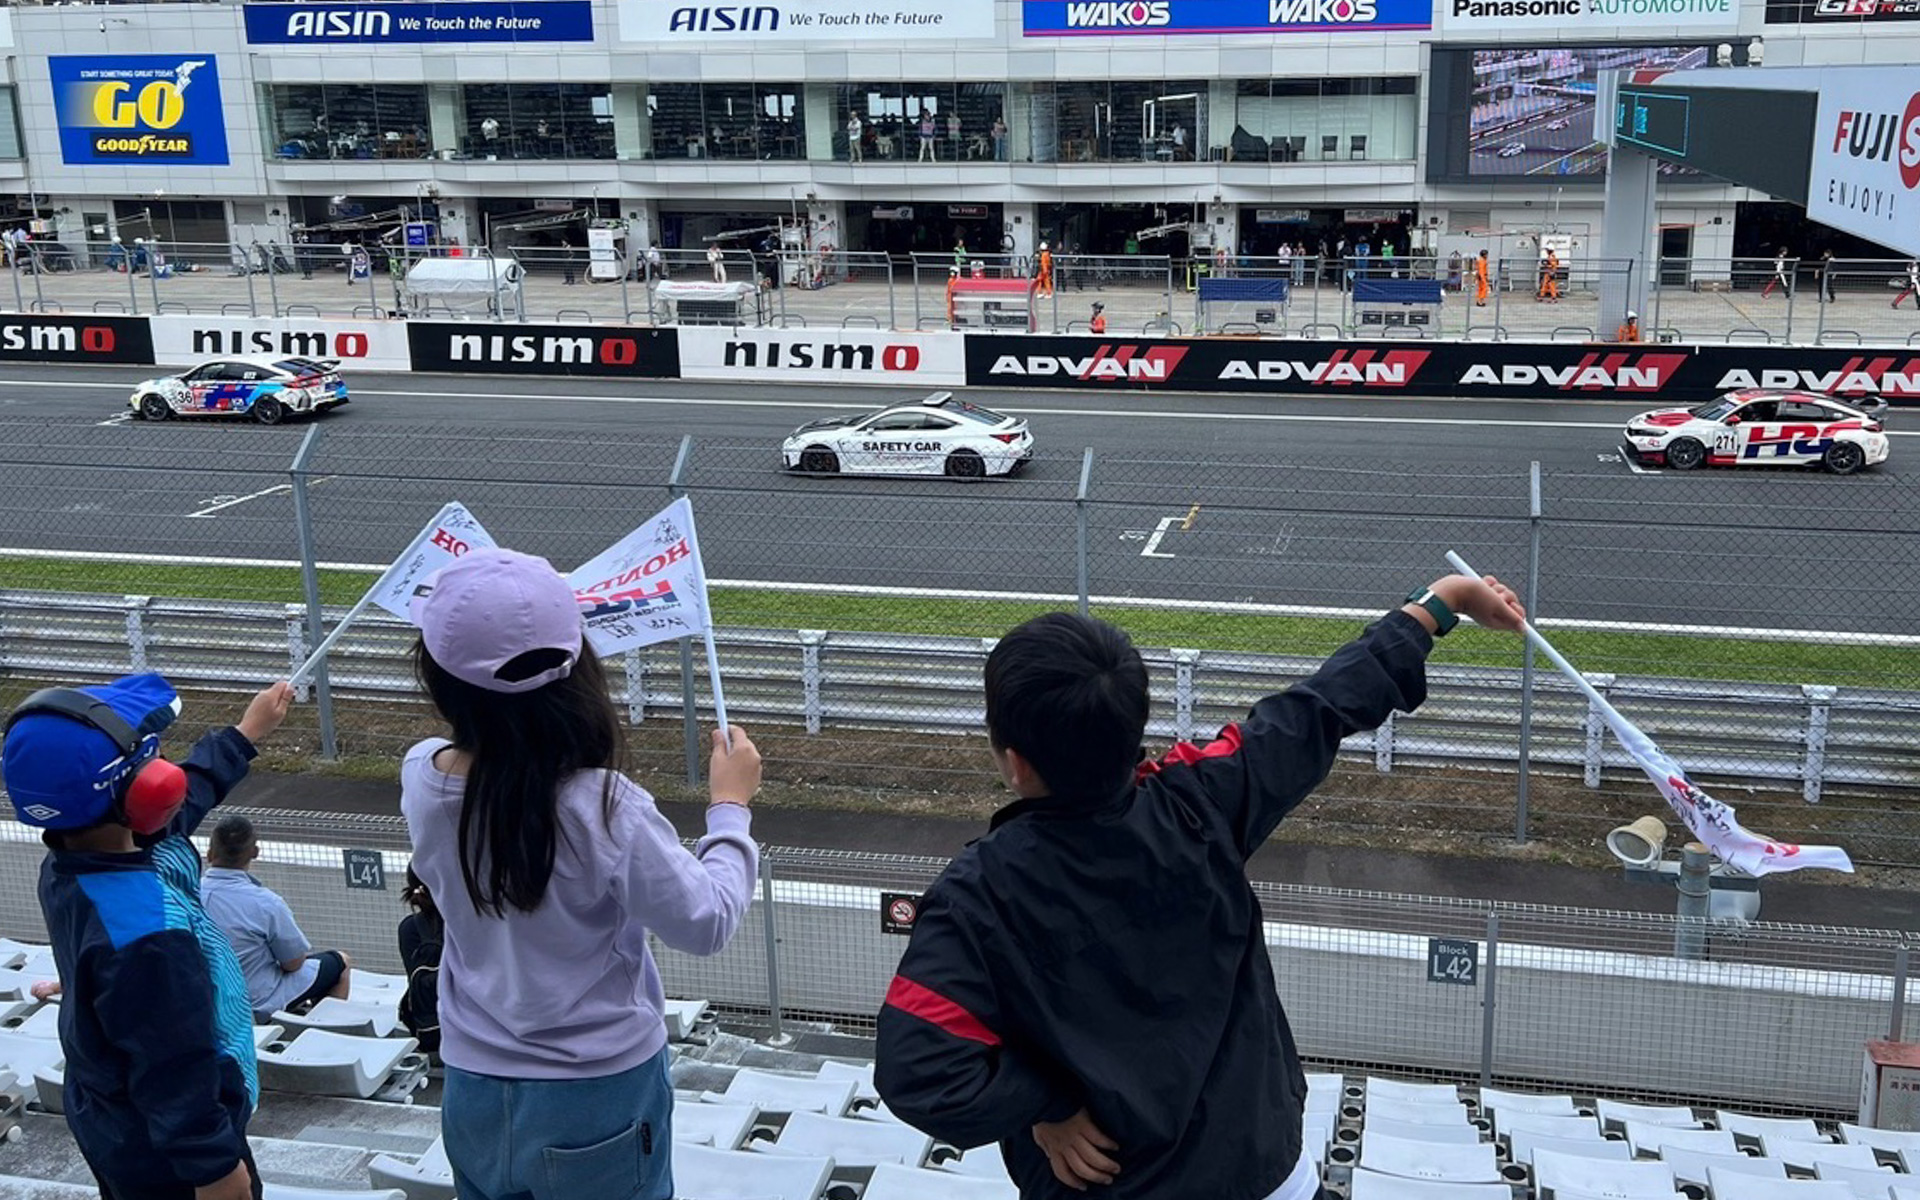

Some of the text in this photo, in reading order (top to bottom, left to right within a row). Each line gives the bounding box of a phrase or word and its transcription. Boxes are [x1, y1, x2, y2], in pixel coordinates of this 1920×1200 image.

[669, 6, 943, 32] AISIN We Touch the Future
[1452, 0, 1581, 17] Panasonic
[286, 11, 542, 37] AISIN We Touch the Future
[93, 79, 185, 130] GO
[96, 136, 189, 154] GOODYEAR
[1828, 179, 1895, 220] ENJOY!
[192, 329, 370, 359] nismo
[449, 333, 638, 366] nismo
[723, 339, 921, 371] nismo
[989, 354, 1166, 378] ADVAN
[1216, 359, 1406, 383] ADVAN
[1458, 364, 1660, 388] ADVAN
[177, 391, 193, 404] 36
[862, 441, 942, 452] SAFETY CAR
[1716, 435, 1736, 450] 271
[349, 863, 380, 886] L41
[1438, 944, 1469, 956] Block
[1433, 955, 1472, 980] L42
